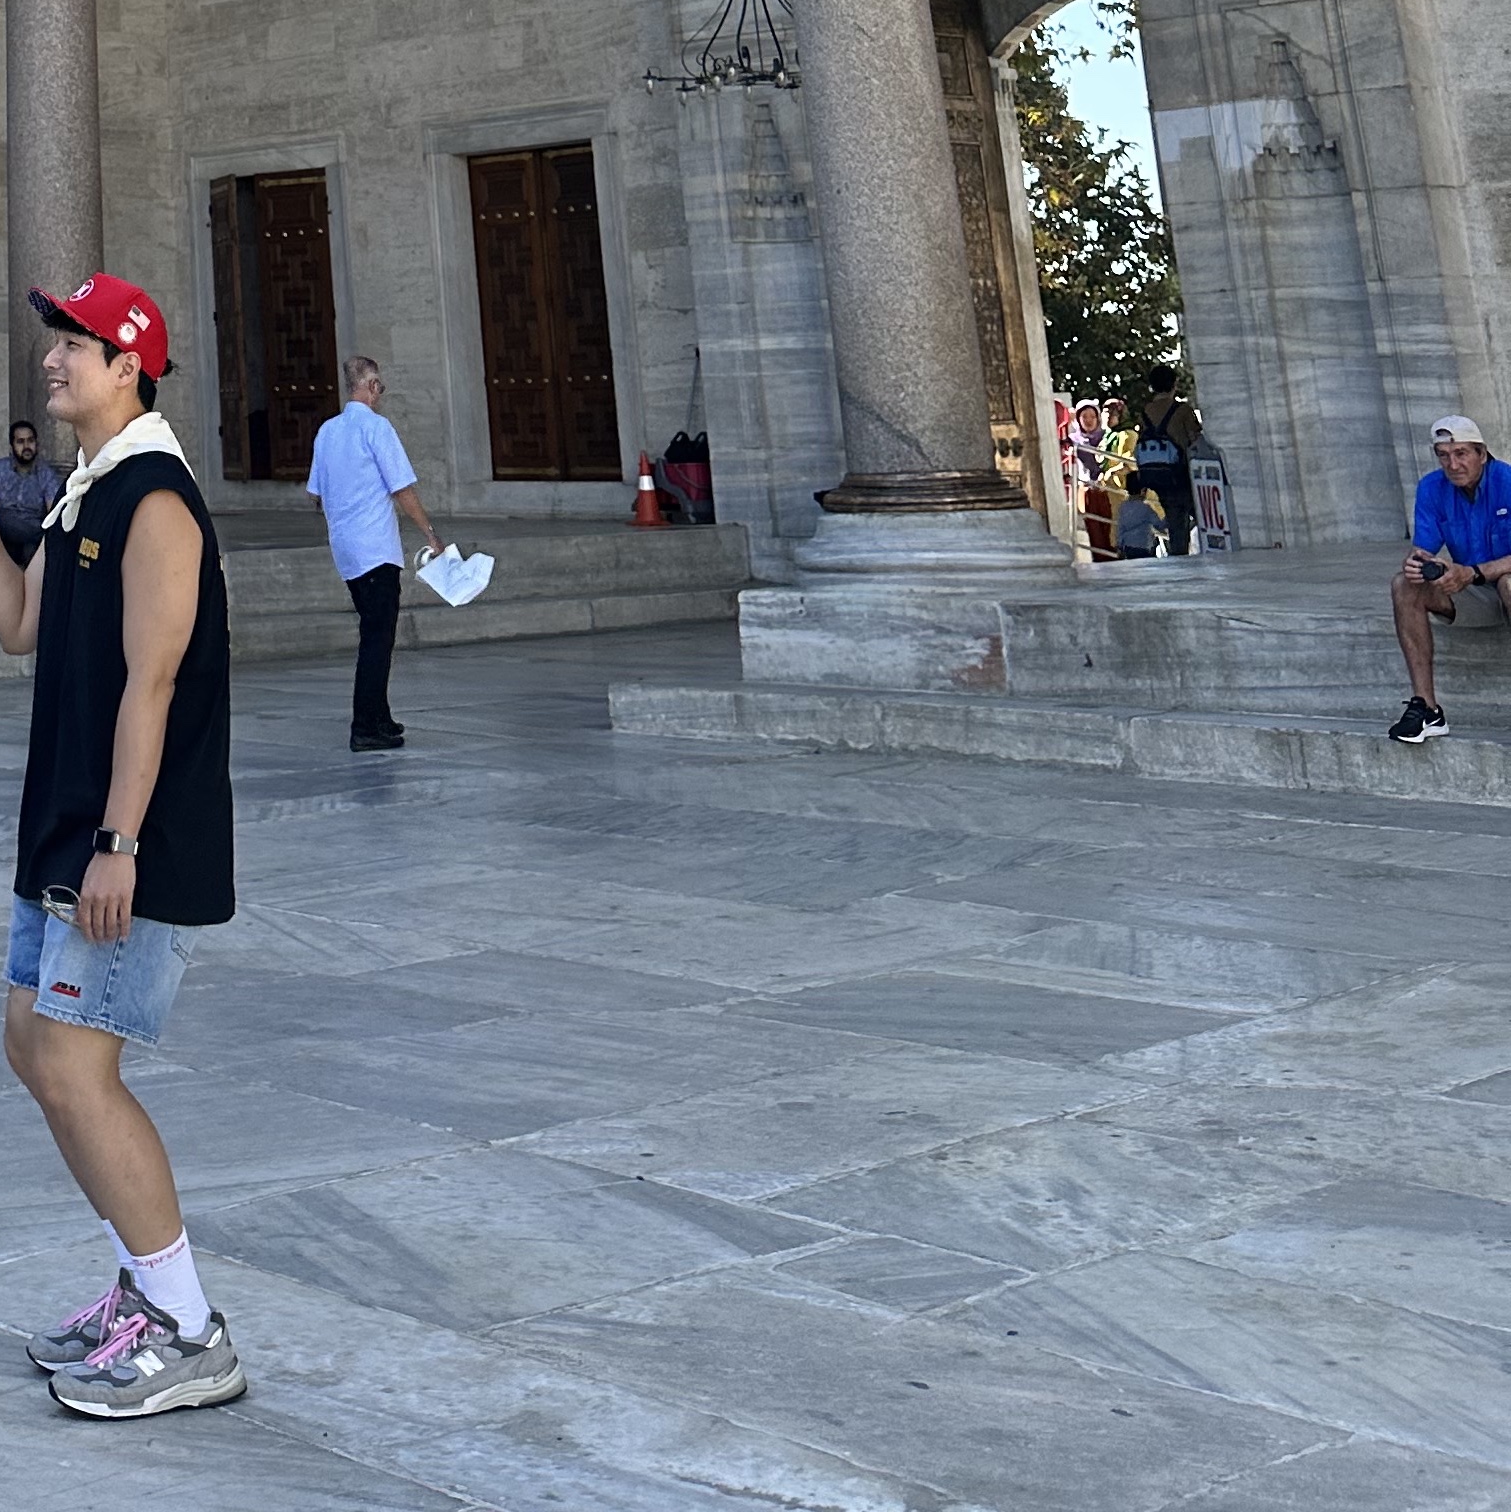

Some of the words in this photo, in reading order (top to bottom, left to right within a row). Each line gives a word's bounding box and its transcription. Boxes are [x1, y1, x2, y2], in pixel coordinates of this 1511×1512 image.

[1197, 484, 1224, 530] WC
[132, 1241, 186, 1269] Supreme
[133, 1349, 166, 1378] N
